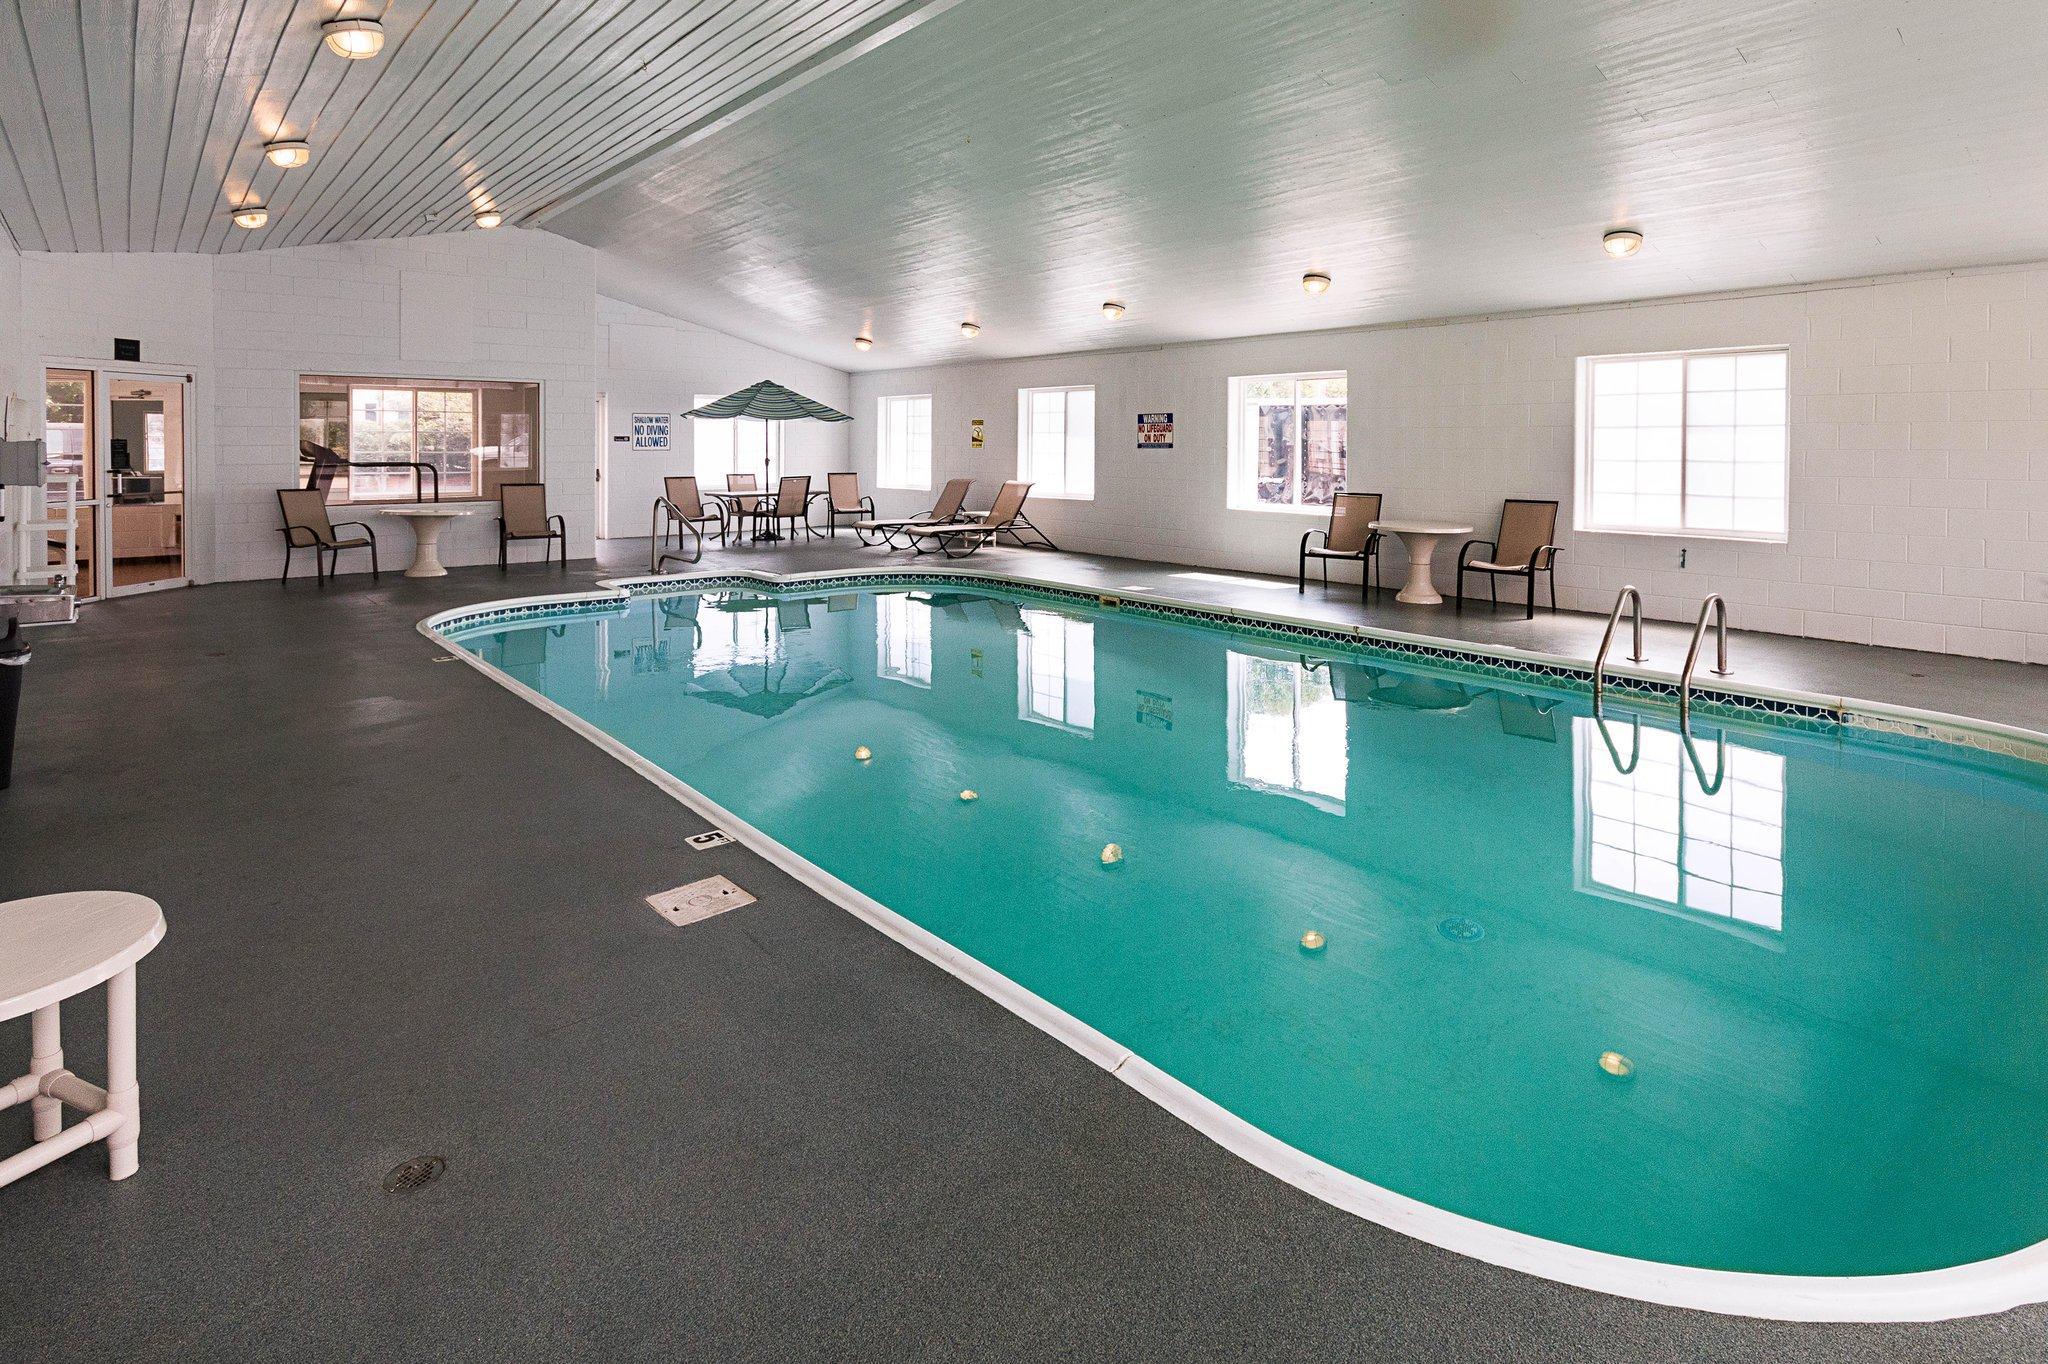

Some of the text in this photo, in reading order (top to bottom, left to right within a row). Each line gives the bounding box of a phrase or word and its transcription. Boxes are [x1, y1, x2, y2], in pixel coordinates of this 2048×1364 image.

[1143, 414, 1168, 423] WARNING
[634, 425, 669, 436] NO DIVING
[1138, 424, 1173, 433] NO LIFEGUARD
[635, 436, 668, 447] ALLOWED
[1144, 434, 1166, 443] ON DUTY
[692, 832, 725, 844] 5
